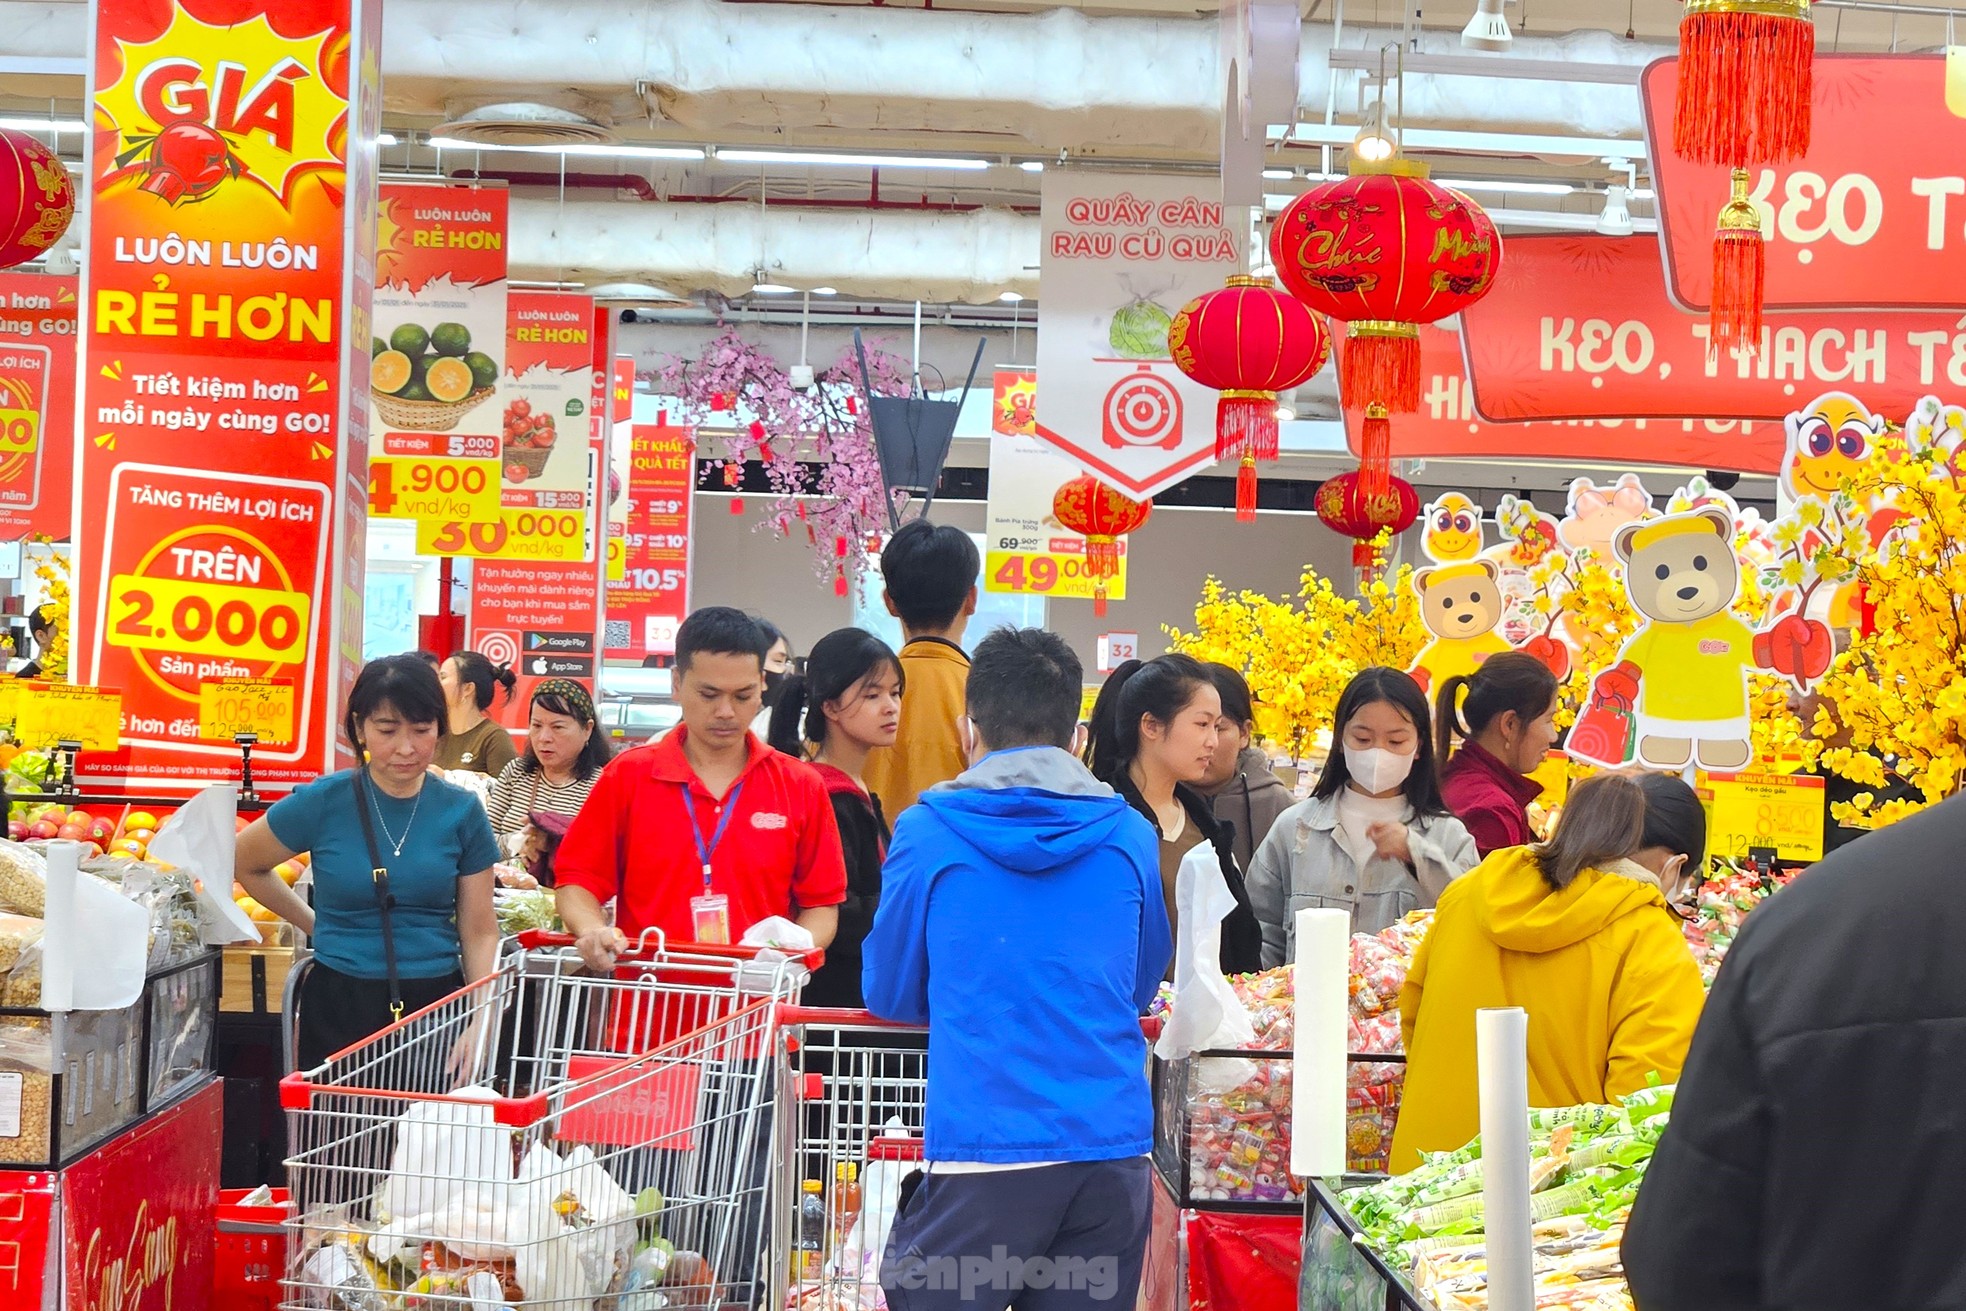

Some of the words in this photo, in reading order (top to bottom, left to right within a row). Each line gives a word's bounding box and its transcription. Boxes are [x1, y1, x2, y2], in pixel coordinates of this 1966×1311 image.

[135, 57, 310, 153] GIÁ
[414, 208, 451, 221] LUÔN
[454, 209, 492, 223] LUÔN
[1067, 193, 1153, 226] QUẦY
[1158, 197, 1223, 227] CÂN
[1911, 176, 1966, 250] T
[413, 225, 445, 248] RẺ
[448, 230, 501, 250] HƠN
[1052, 231, 1116, 258] RAU
[1120, 229, 1165, 260] CỦ
[1169, 230, 1238, 262] QUẢ
[1298, 223, 1383, 269] Chúc
[115, 232, 211, 265] LUÔN
[222, 237, 317, 270] LUÔN
[12, 292, 51, 310] hơn
[96, 273, 179, 336] RẺ
[190, 292, 332, 343] HƠN
[517, 310, 547, 321] LUÔN
[549, 311, 579, 322] LUÔN
[39, 318, 77, 335] GO!
[516, 323, 542, 342] RẺ
[544, 327, 588, 344] HƠN
[0, 356, 17, 369] ỢI
[1540, 316, 1672, 389] KẸO,
[132, 372, 181, 396] Tiết
[187, 375, 246, 402] kiệm
[253, 379, 299, 402] hơn
[1011, 392, 1036, 409] GI
[98, 400, 144, 425] mỗi
[151, 407, 211, 432] ngày
[218, 409, 278, 434] cùng
[285, 412, 331, 433] GO!
[388, 438, 406, 449] TIẾT
[447, 436, 495, 456] 5.000
[465, 449, 494, 458] vnd/kg
[634, 455, 663, 471] QUÀ
[666, 455, 688, 470] TẾT
[2, 490, 27, 501] năm
[129, 485, 183, 508] TĂNG
[187, 492, 240, 514] THÊM
[244, 498, 276, 520] LỢI
[280, 498, 314, 522] ÍCH
[404, 497, 470, 519] vnd/kg
[432, 513, 578, 554] 30.000
[511, 540, 564, 557] vnd/kg
[171, 545, 261, 583] TRÊN
[479, 567, 499, 578] Tận
[501, 568, 534, 580] hưởng
[537, 570, 563, 581] ngay
[477, 582, 516, 594] khuyến
[518, 584, 537, 593] mãi
[539, 585, 566, 595] dành
[568, 585, 595, 597] riêng
[481, 598, 501, 607] cho
[503, 598, 523, 609] bạn
[525, 599, 541, 609] khi
[543, 602, 566, 610] mua
[568, 600, 590, 610] sắm
[115, 589, 300, 651] 2.000
[506, 613, 528, 623] trực
[549, 638, 573, 647] Google
[572, 639, 587, 648] Play
[1112, 644, 1133, 657] 32
[160, 655, 194, 674] Sản
[198, 658, 250, 679] phẩm
[551, 662, 567, 671] App
[566, 663, 584, 671] Store
[131, 714, 165, 733] hơn
[168, 718, 201, 736] đến
[101, 764, 112, 772] SO
[113, 764, 133, 772] SÁNH
[1735, 773, 1777, 784] KHUYẾN
[1778, 775, 1797, 785] MÃI
